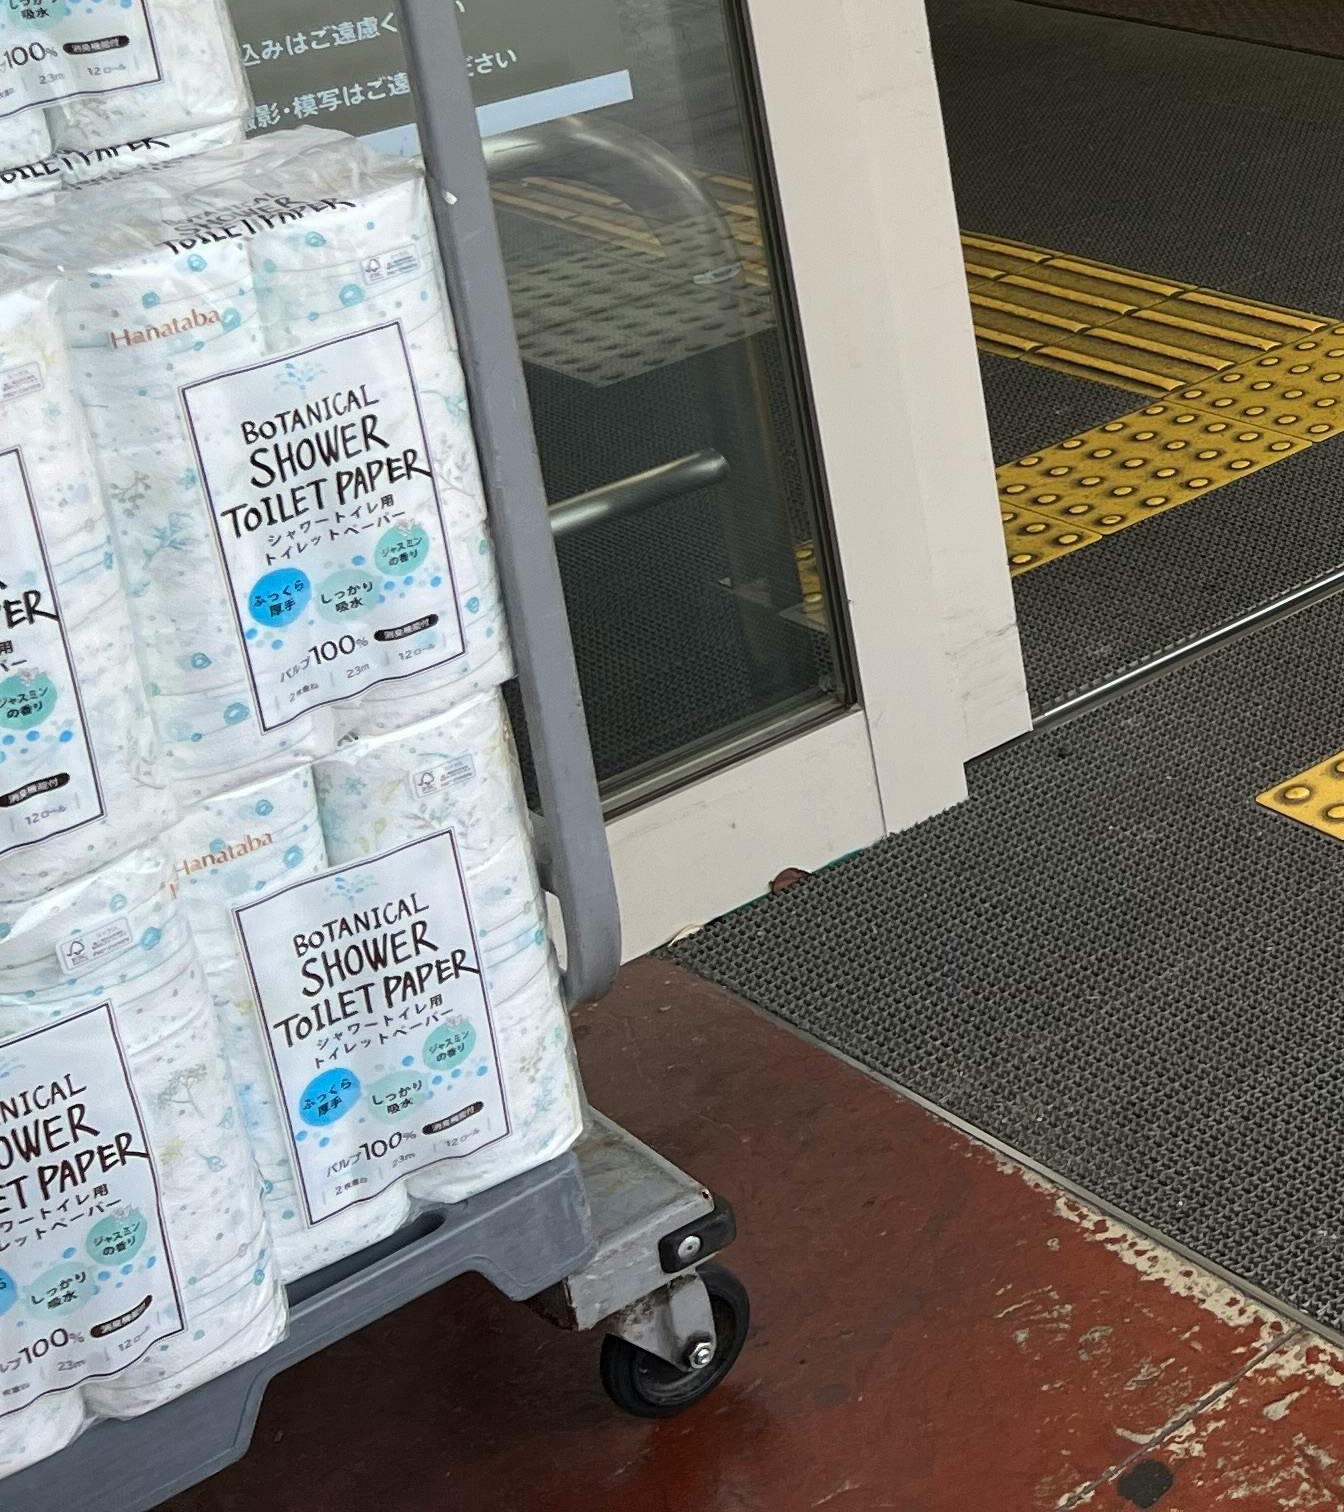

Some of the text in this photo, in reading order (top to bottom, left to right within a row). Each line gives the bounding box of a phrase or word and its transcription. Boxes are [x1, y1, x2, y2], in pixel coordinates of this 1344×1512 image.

[21, 5, 50, 21] 吸水
[39, 72, 65, 85] 23m
[110, 308, 222, 350] Hanataba
[241, 384, 380, 446] BOTANICAL
[249, 413, 390, 489] SHOWER
[220, 448, 434, 539] TOILET PAPER
[267, 494, 395, 547] シャワートイレ用
[266, 511, 406, 566] トイレットペーパー
[382, 537, 423, 558] ジャスミン
[388, 549, 419, 567] の香り
[252, 579, 305, 607] ふっくら
[320, 581, 374, 605] しっかり
[335, 597, 364, 614] 吸水
[269, 599, 297, 618] 厚手
[346, 662, 371, 679] 23m
[6, 700, 44, 719] の香り
[292, 892, 430, 959] BOTANICAL
[301, 920, 439, 998] SHOWER
[272, 948, 482, 1048] TOILET PAPER
[316, 994, 444, 1051] シャワートイレ用
[314, 1008, 454, 1069] トイレットペーパー
[436, 1043, 466, 1063] の香り
[301, 1077, 353, 1111] ふっくら
[371, 1079, 424, 1106] しっかり
[317, 1097, 343, 1117] 厚手
[386, 1098, 415, 1116] 吸水
[37, 1131, 151, 1202] PAPER
[93, 1220, 141, 1248] ジャスミン
[102, 1235, 136, 1257] の香り
[30, 1271, 88, 1306] しっかり
[56, 1358, 87, 1372] 23m
